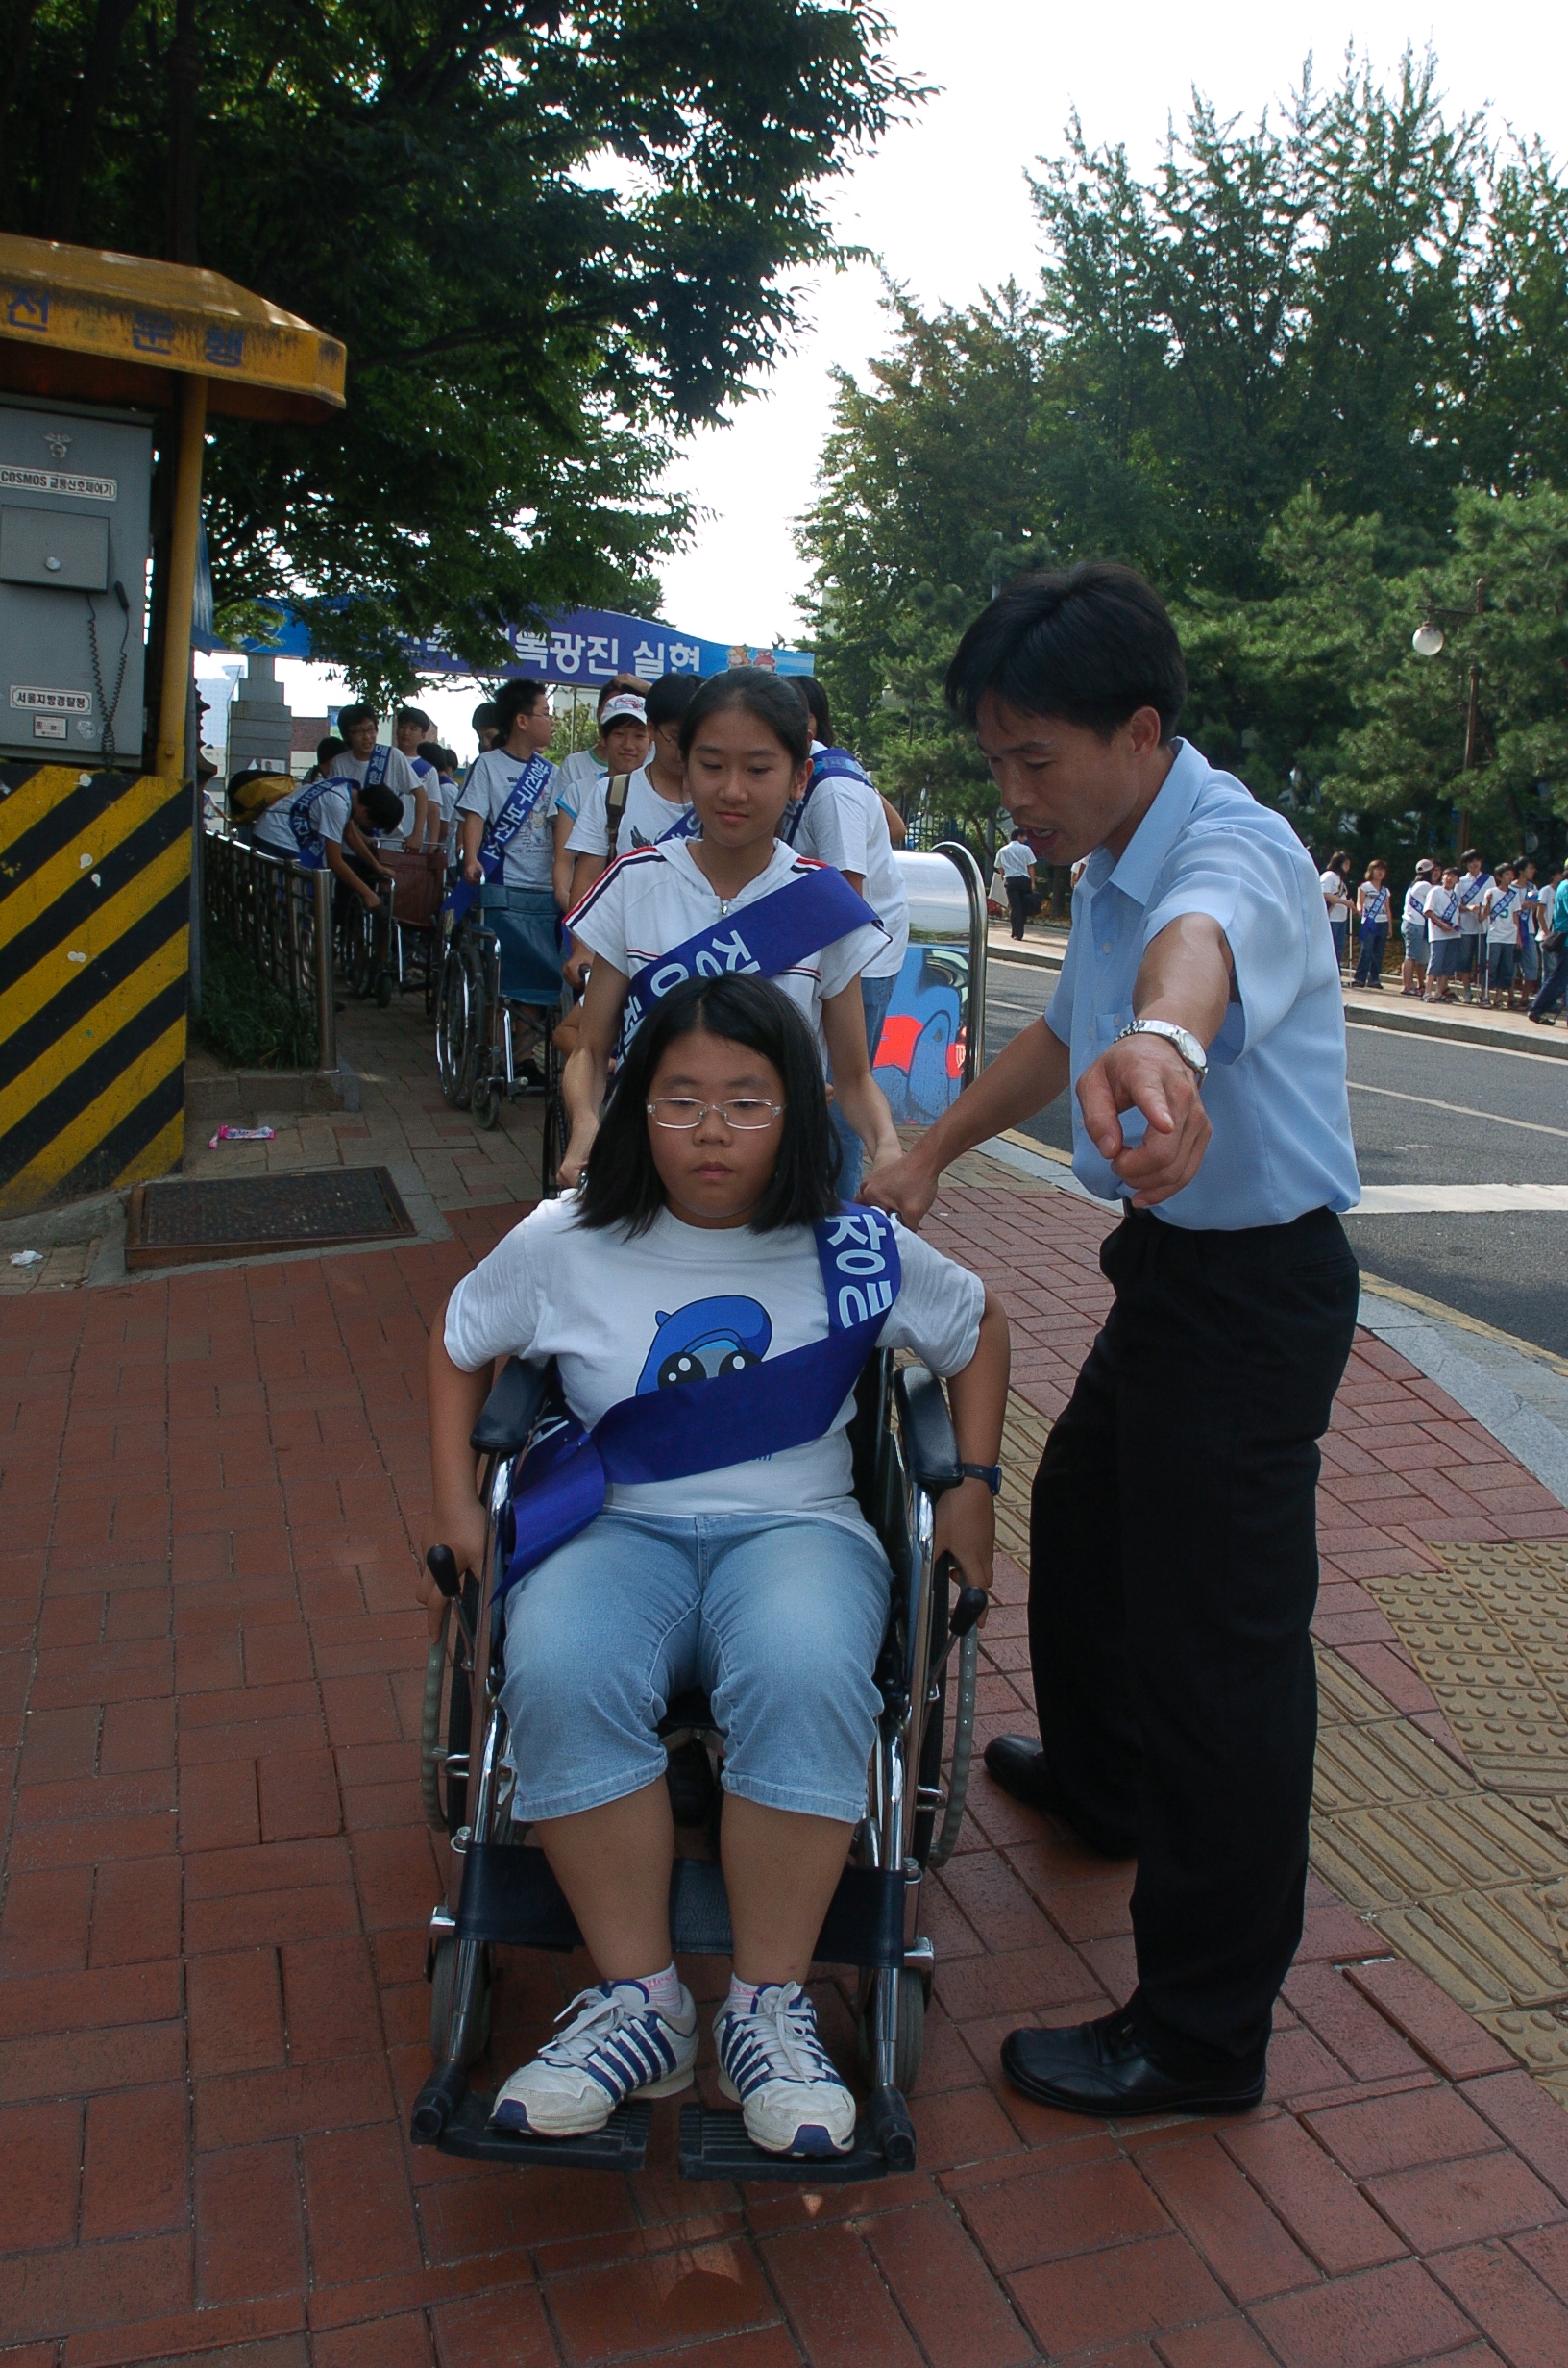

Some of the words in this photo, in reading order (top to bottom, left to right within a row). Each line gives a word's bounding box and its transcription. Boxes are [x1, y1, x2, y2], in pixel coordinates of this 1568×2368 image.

[133, 311, 244, 368] 운행
[1, 470, 47, 487] COSMOS
[633, 640, 700, 679] 실현
